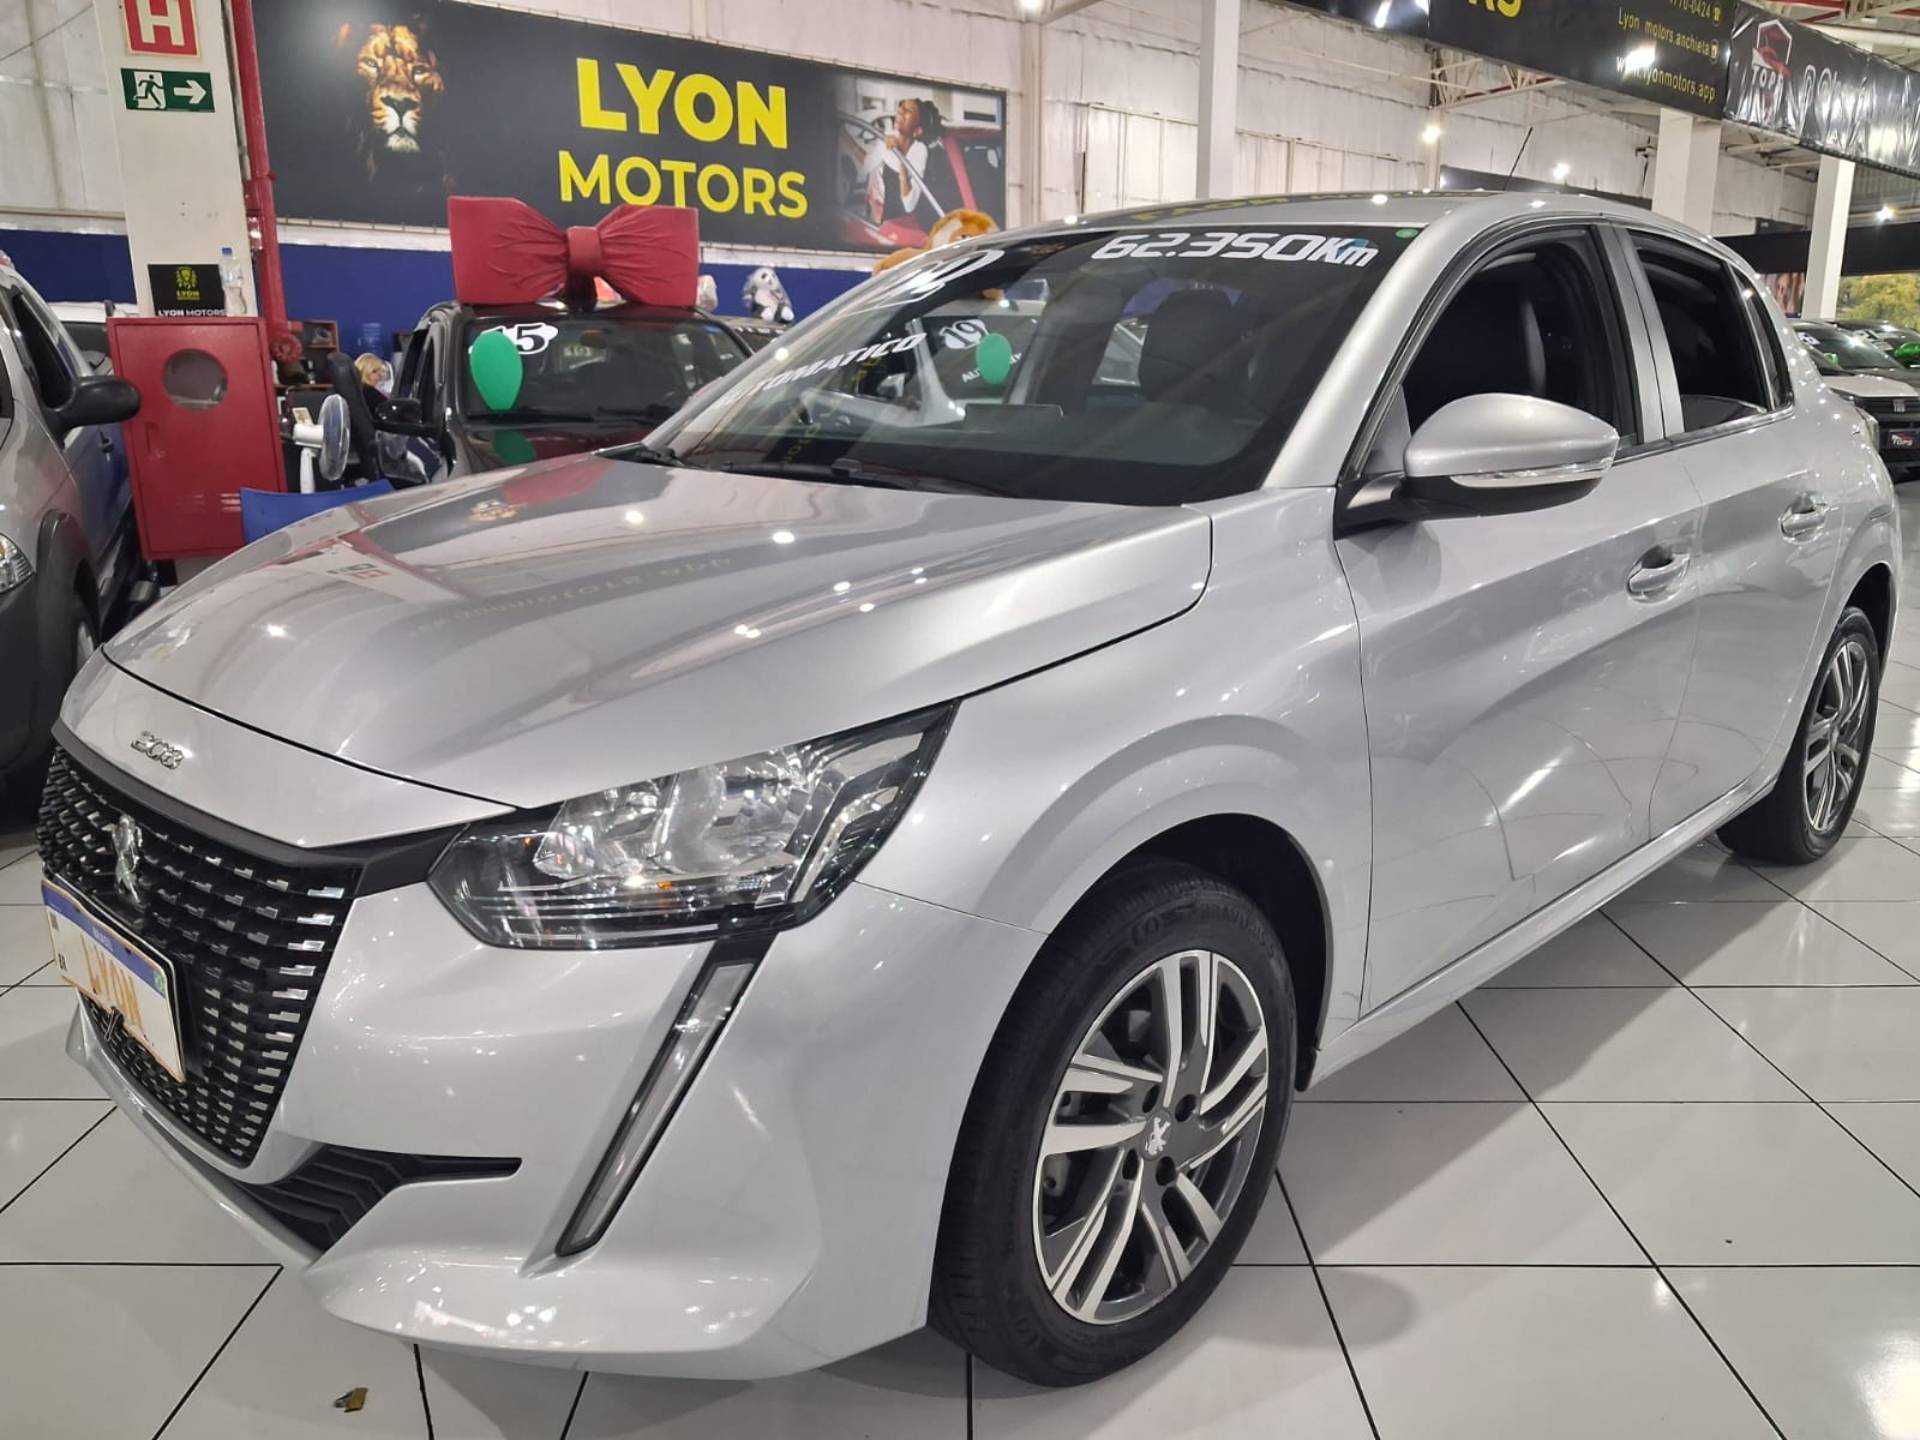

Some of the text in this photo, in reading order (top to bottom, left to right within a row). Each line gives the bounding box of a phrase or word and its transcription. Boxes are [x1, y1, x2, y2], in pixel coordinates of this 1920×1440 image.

[132, 0, 185, 46] H
[1618, 7, 1641, 30] Lyon
[577, 57, 788, 149] LYON
[559, 150, 808, 218] MOTORS
[1092, 232, 1379, 268] 62.350Km
[158, 308, 225, 317] LYON MOTORS
[130, 731, 184, 770] 208
